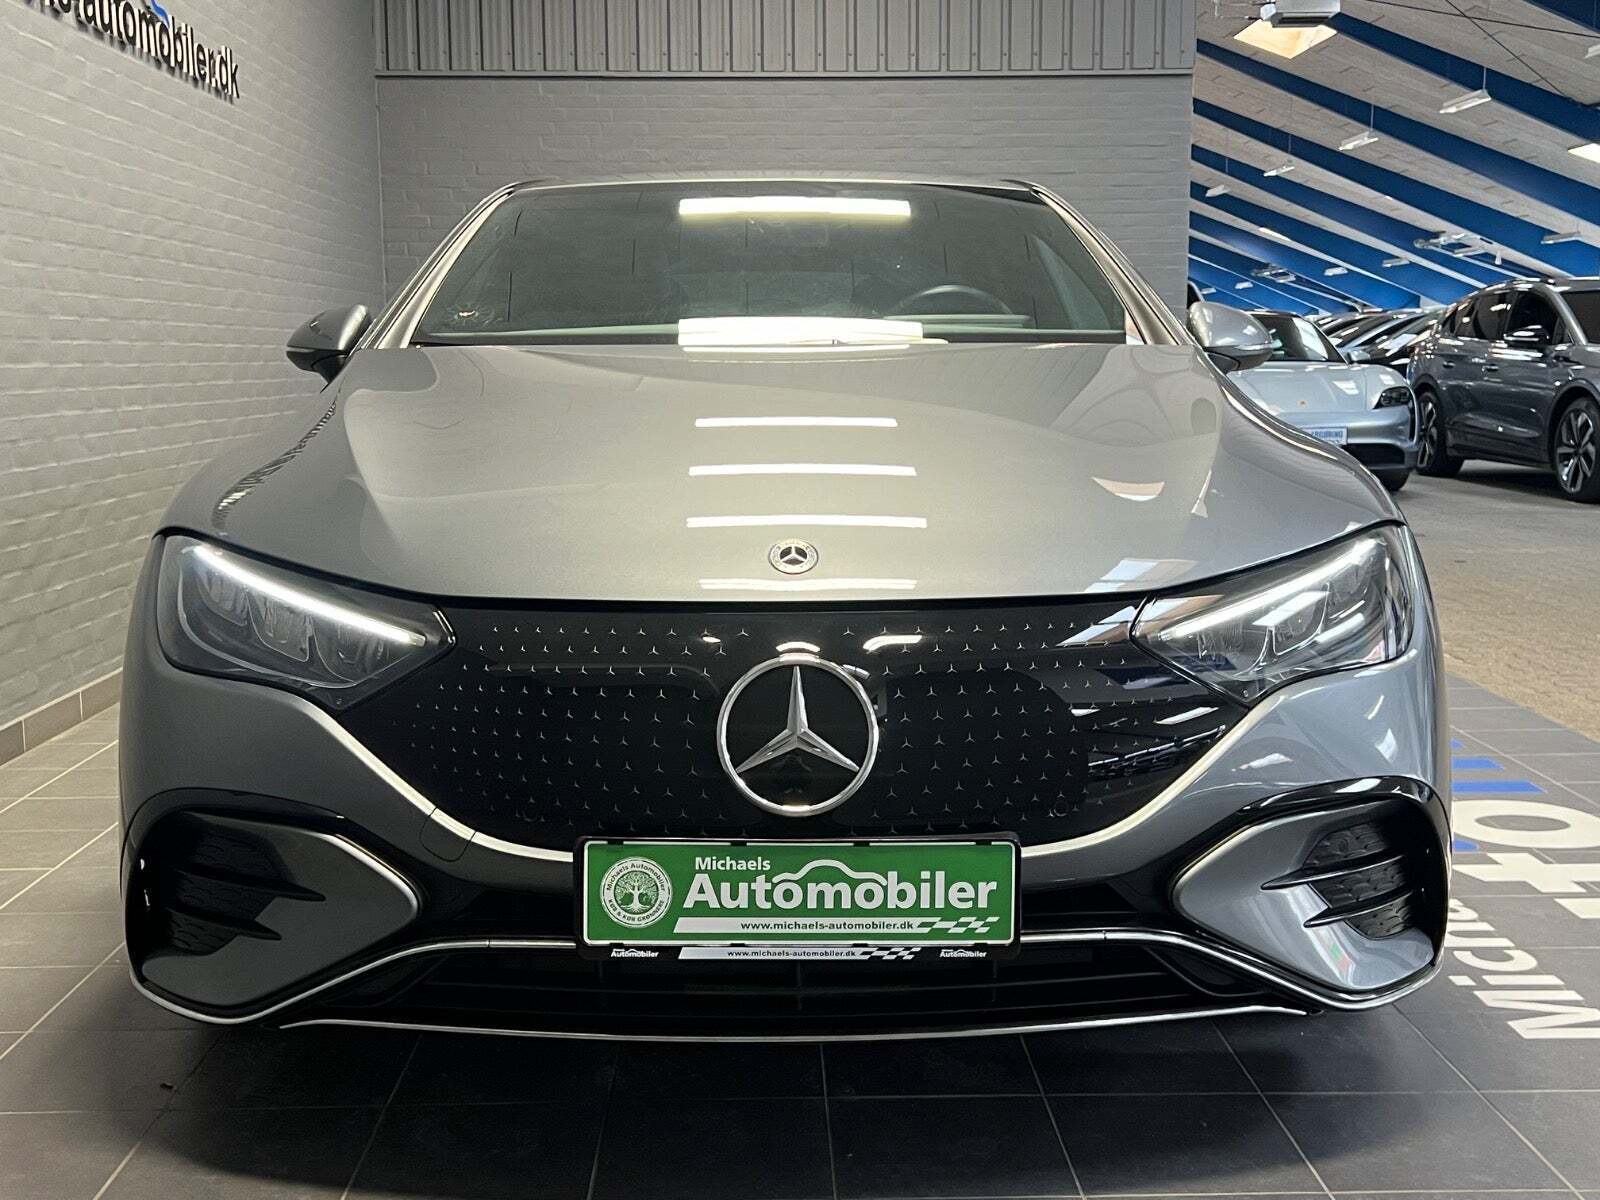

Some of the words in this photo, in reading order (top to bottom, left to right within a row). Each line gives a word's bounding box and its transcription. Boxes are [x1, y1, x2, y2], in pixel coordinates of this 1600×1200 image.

[695, 856, 771, 871] Michaels
[606, 865, 629, 891] Michaels
[630, 863, 666, 891] Automobiler
[682, 870, 998, 910] Automobiler
[740, 920, 914, 930] www.michaels-automobiler.dk
[610, 950, 660, 958] Automobiler
[939, 950, 988, 958] Automobiler
